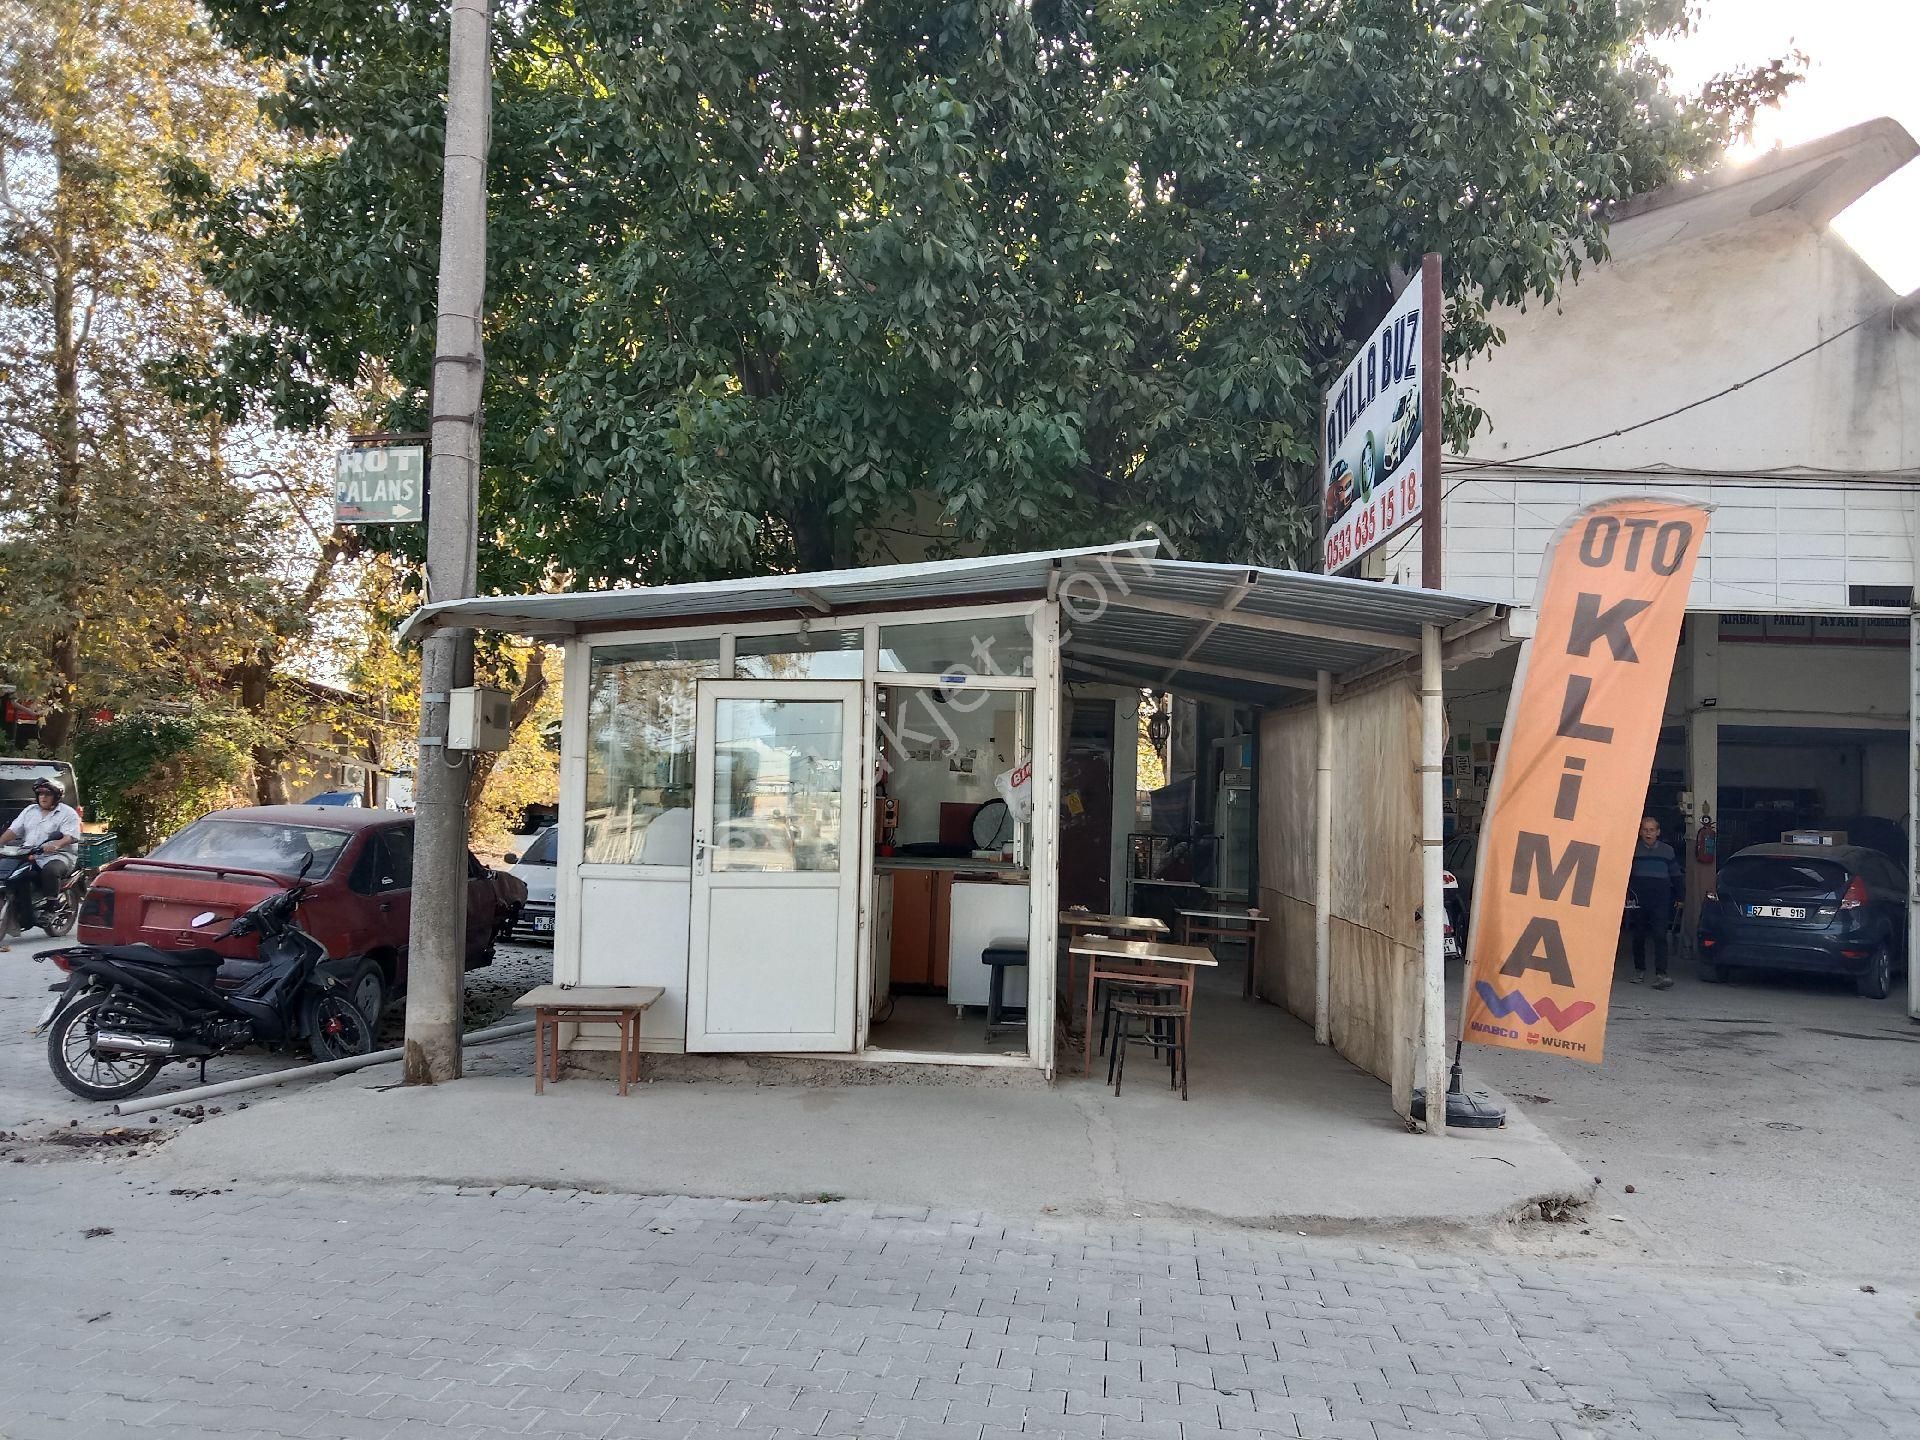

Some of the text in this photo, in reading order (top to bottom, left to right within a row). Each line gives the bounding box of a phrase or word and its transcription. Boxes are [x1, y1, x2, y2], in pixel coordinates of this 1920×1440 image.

[1381, 308, 1419, 393] BUZ
[340, 449, 419, 473] ROT
[1327, 469, 1416, 571] 0533 635 15 18
[1579, 516, 1693, 577] OTO
[1753, 907, 1805, 918] 67 VE 916
[1471, 1021, 1586, 1052] WABCO WÜRTH
